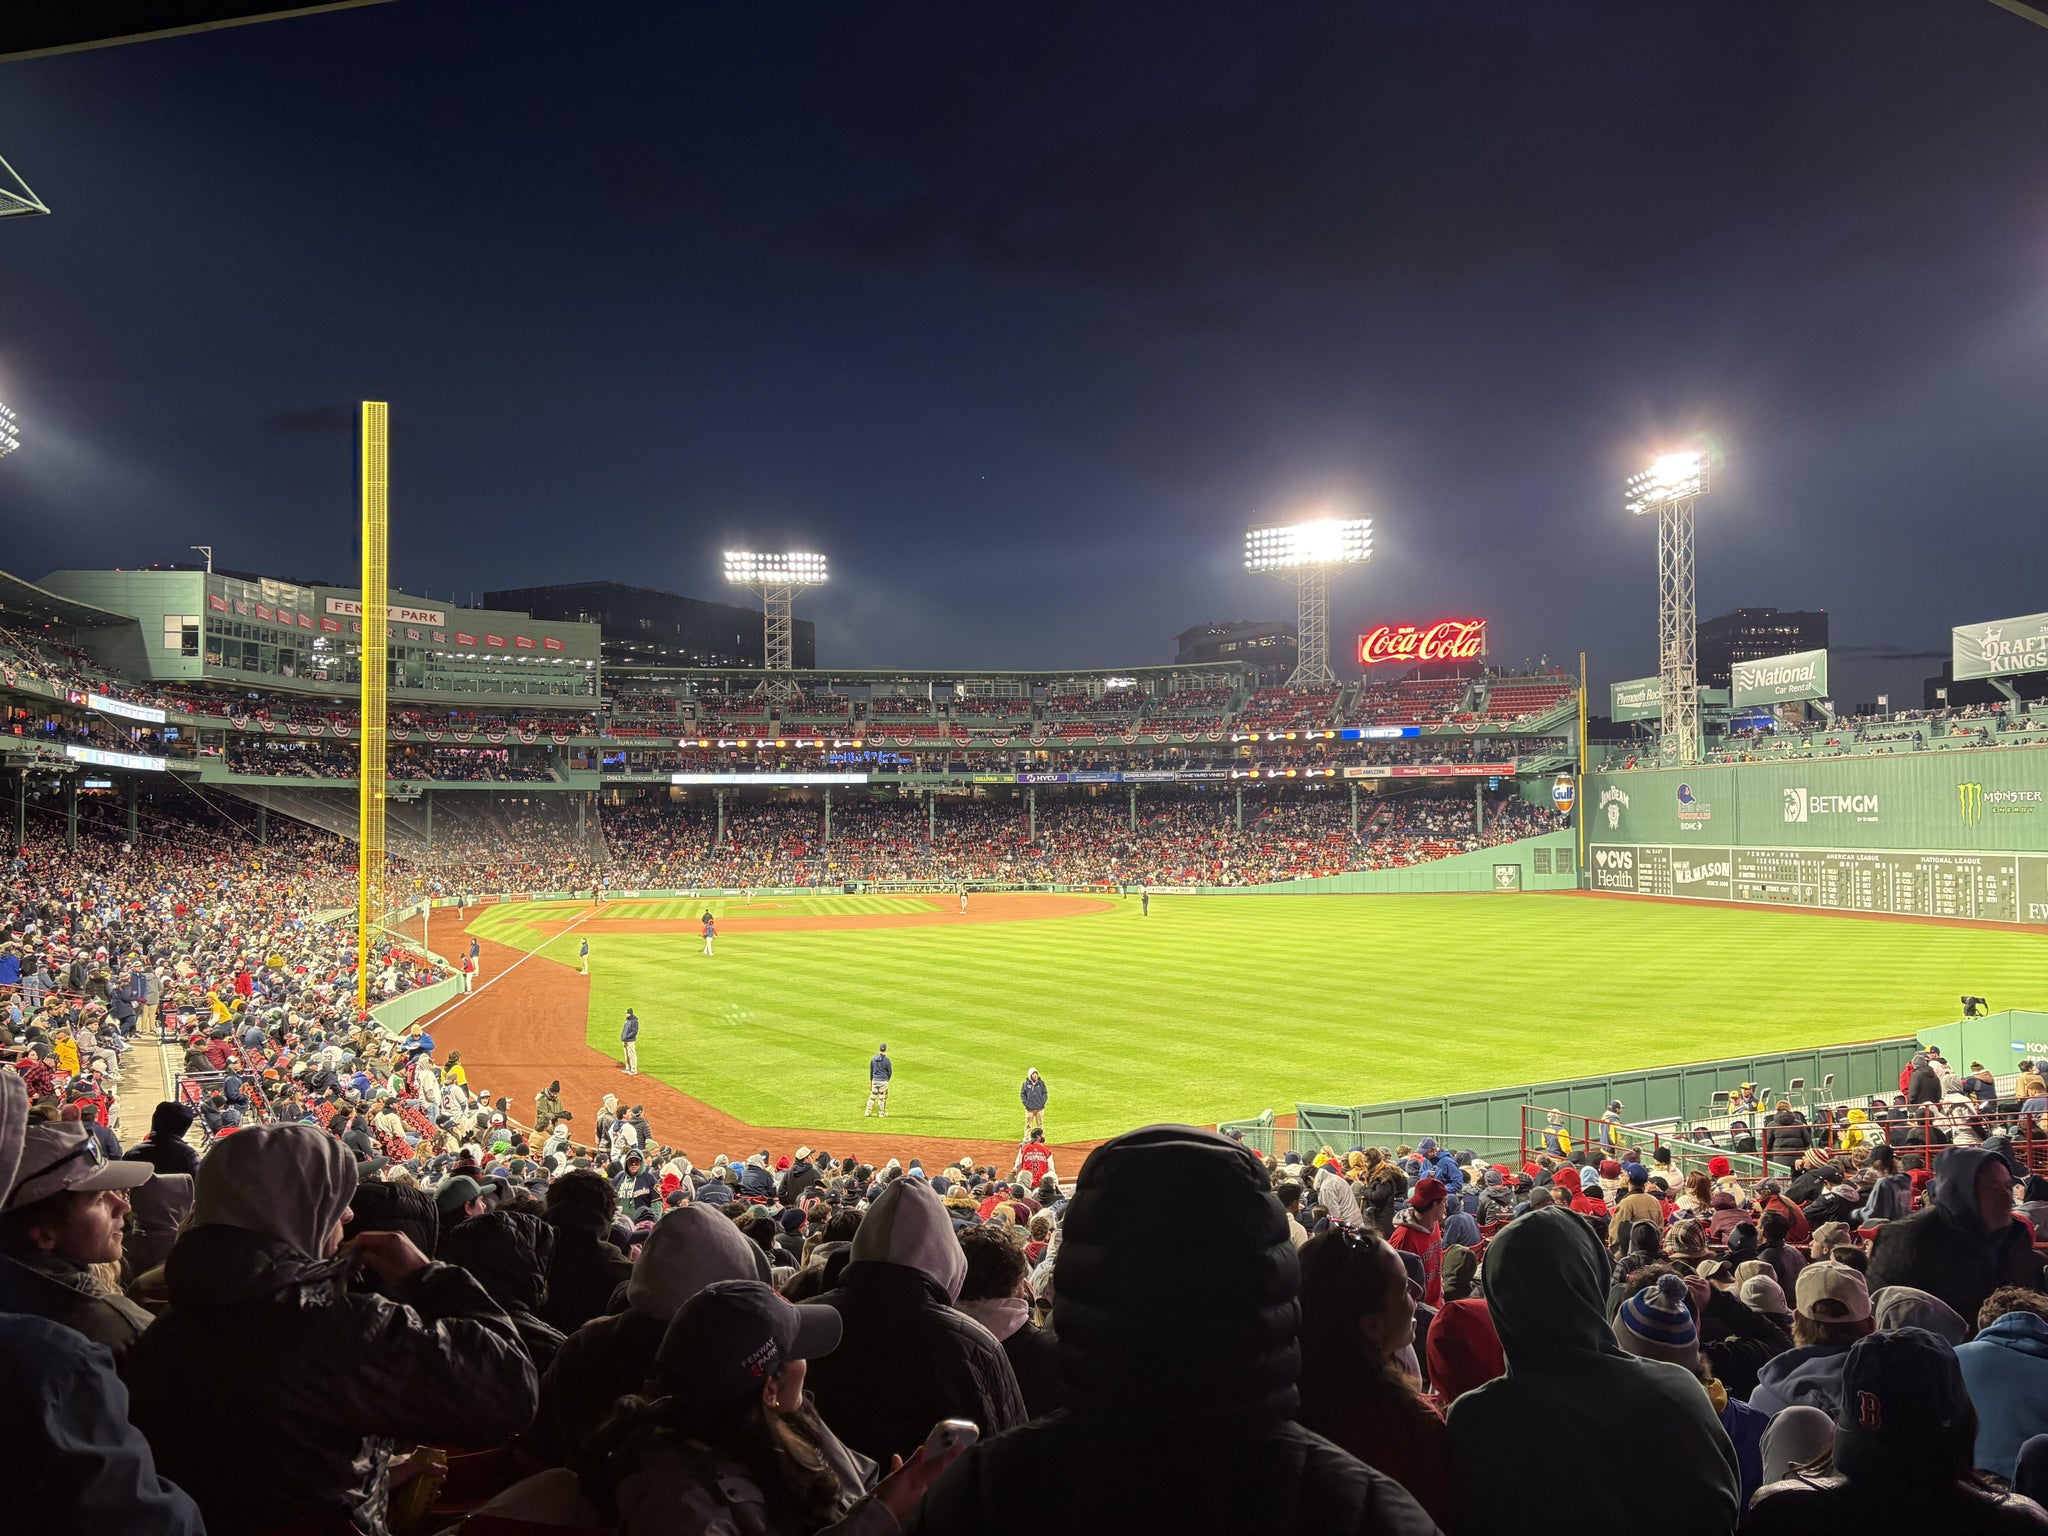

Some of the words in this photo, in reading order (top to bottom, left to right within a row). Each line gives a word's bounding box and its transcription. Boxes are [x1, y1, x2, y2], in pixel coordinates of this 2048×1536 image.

[401, 610, 437, 623] PARK
[1362, 621, 1487, 662] Coca-Cola
[1982, 635, 2048, 661] DRAFT
[1990, 652, 2048, 673] KINGS
[1616, 690, 1646, 705] Plymouth
[1775, 685, 1787, 695] Car
[1788, 682, 1812, 693] Rental
[1553, 787, 1574, 800] Gulf
[1810, 795, 1878, 813] BETMGM
[1607, 850, 1633, 869] CVS
[1597, 869, 1633, 888] Health
[757, 1344, 778, 1368] PARK
[1857, 1390, 1881, 1431] B
